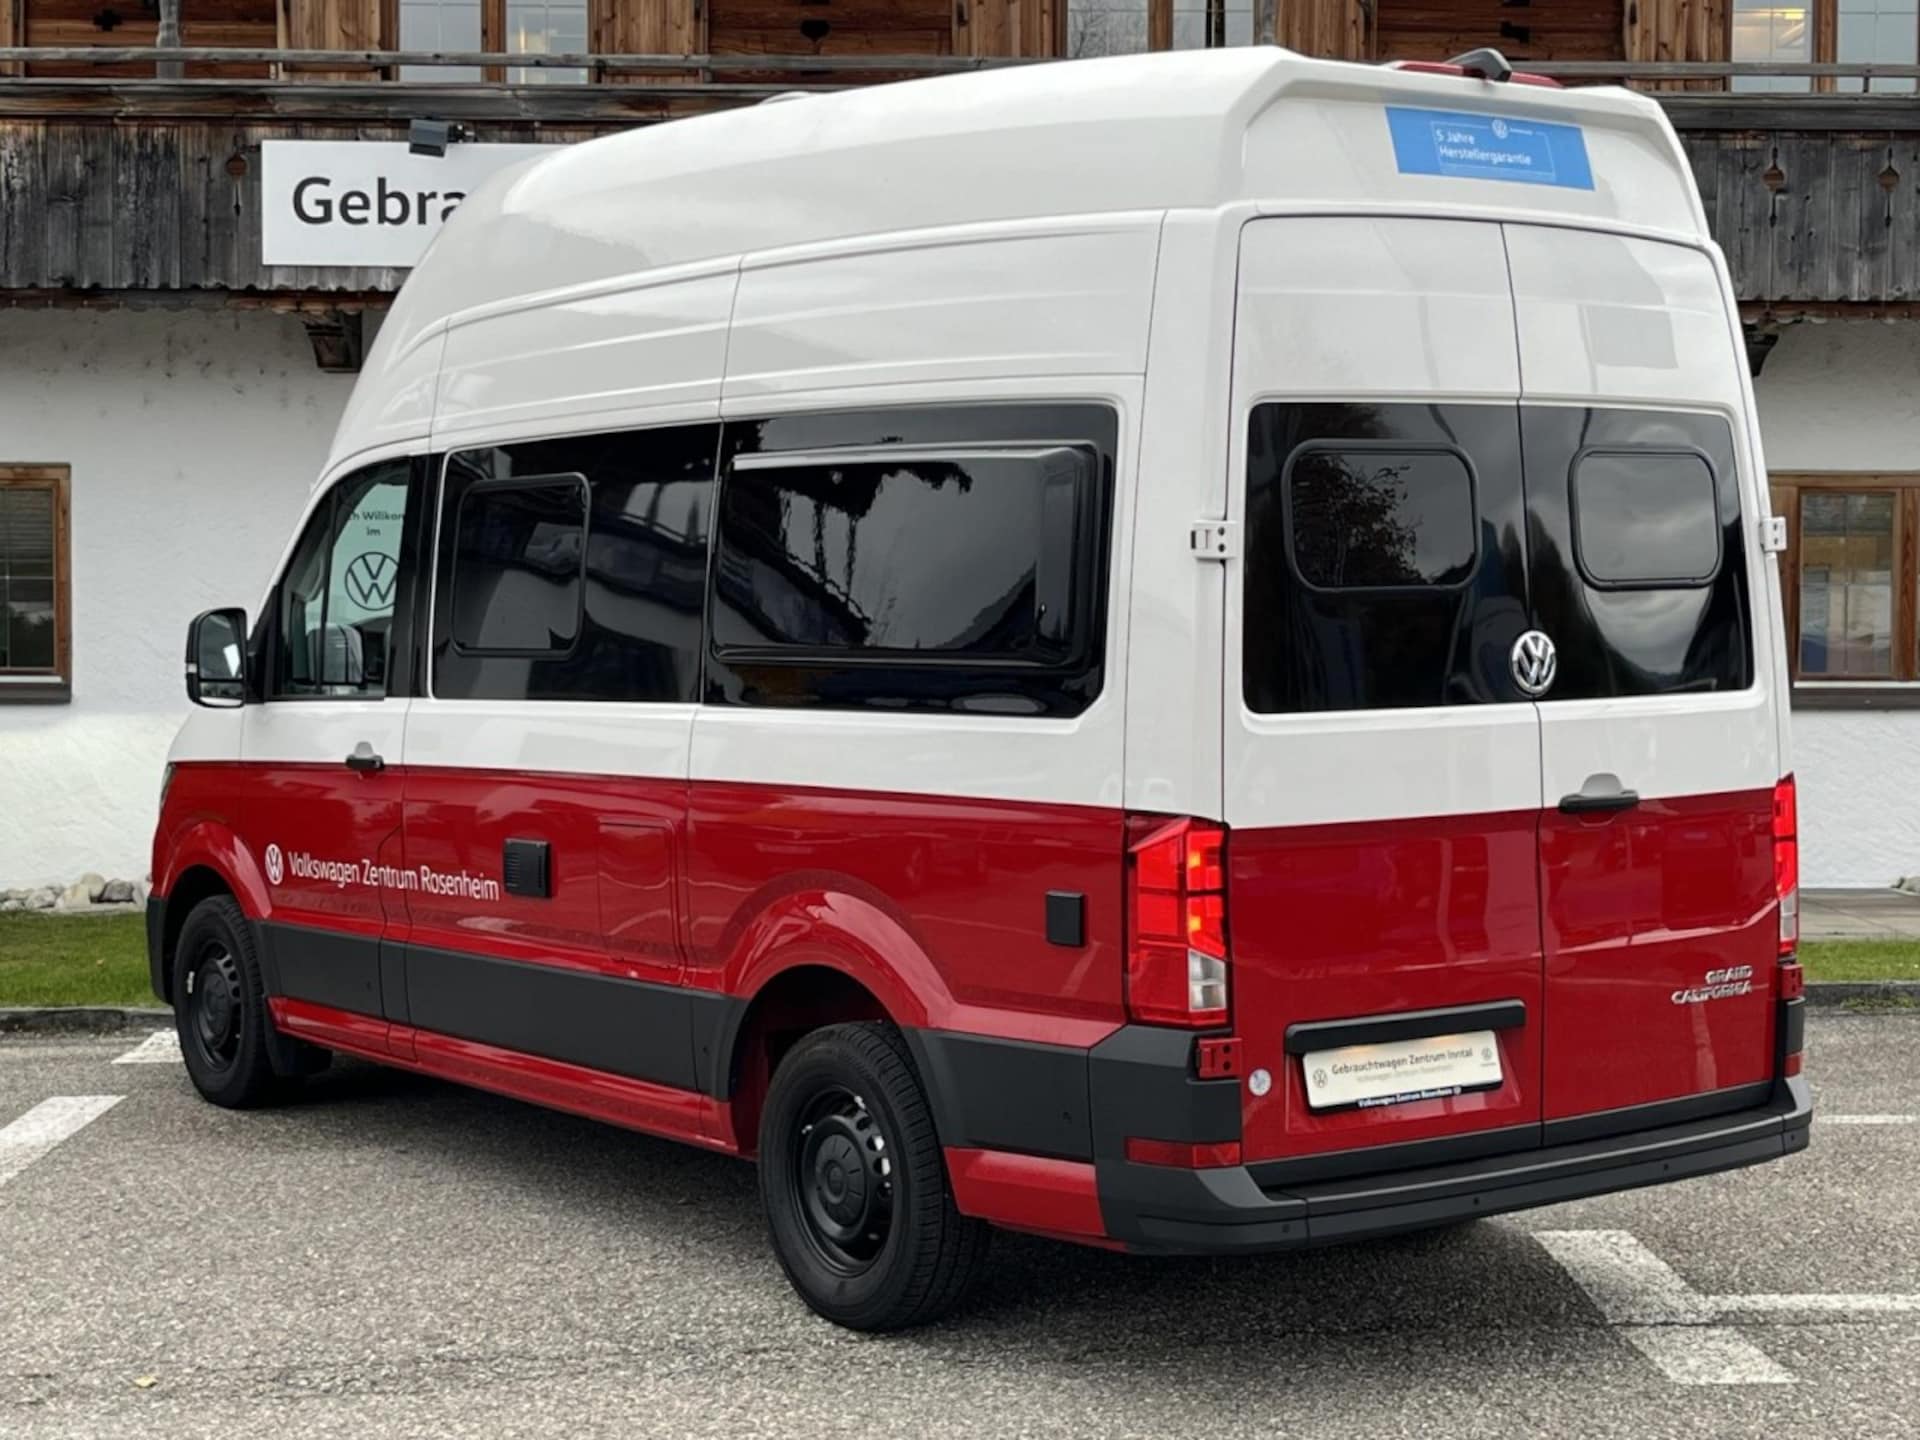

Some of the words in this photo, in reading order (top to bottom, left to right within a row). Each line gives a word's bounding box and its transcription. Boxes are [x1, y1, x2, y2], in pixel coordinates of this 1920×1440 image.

[1447, 132, 1475, 146] Jahre
[1440, 146, 1532, 166] Herstellergarantie
[366, 526, 381, 536] im
[288, 851, 361, 888] Volkswagen
[362, 859, 419, 890] Zentrum
[420, 865, 500, 901] Rosenheim
[1331, 1056, 1408, 1076] Gebrauchtwagen
[1409, 1052, 1446, 1065] Zentrum
